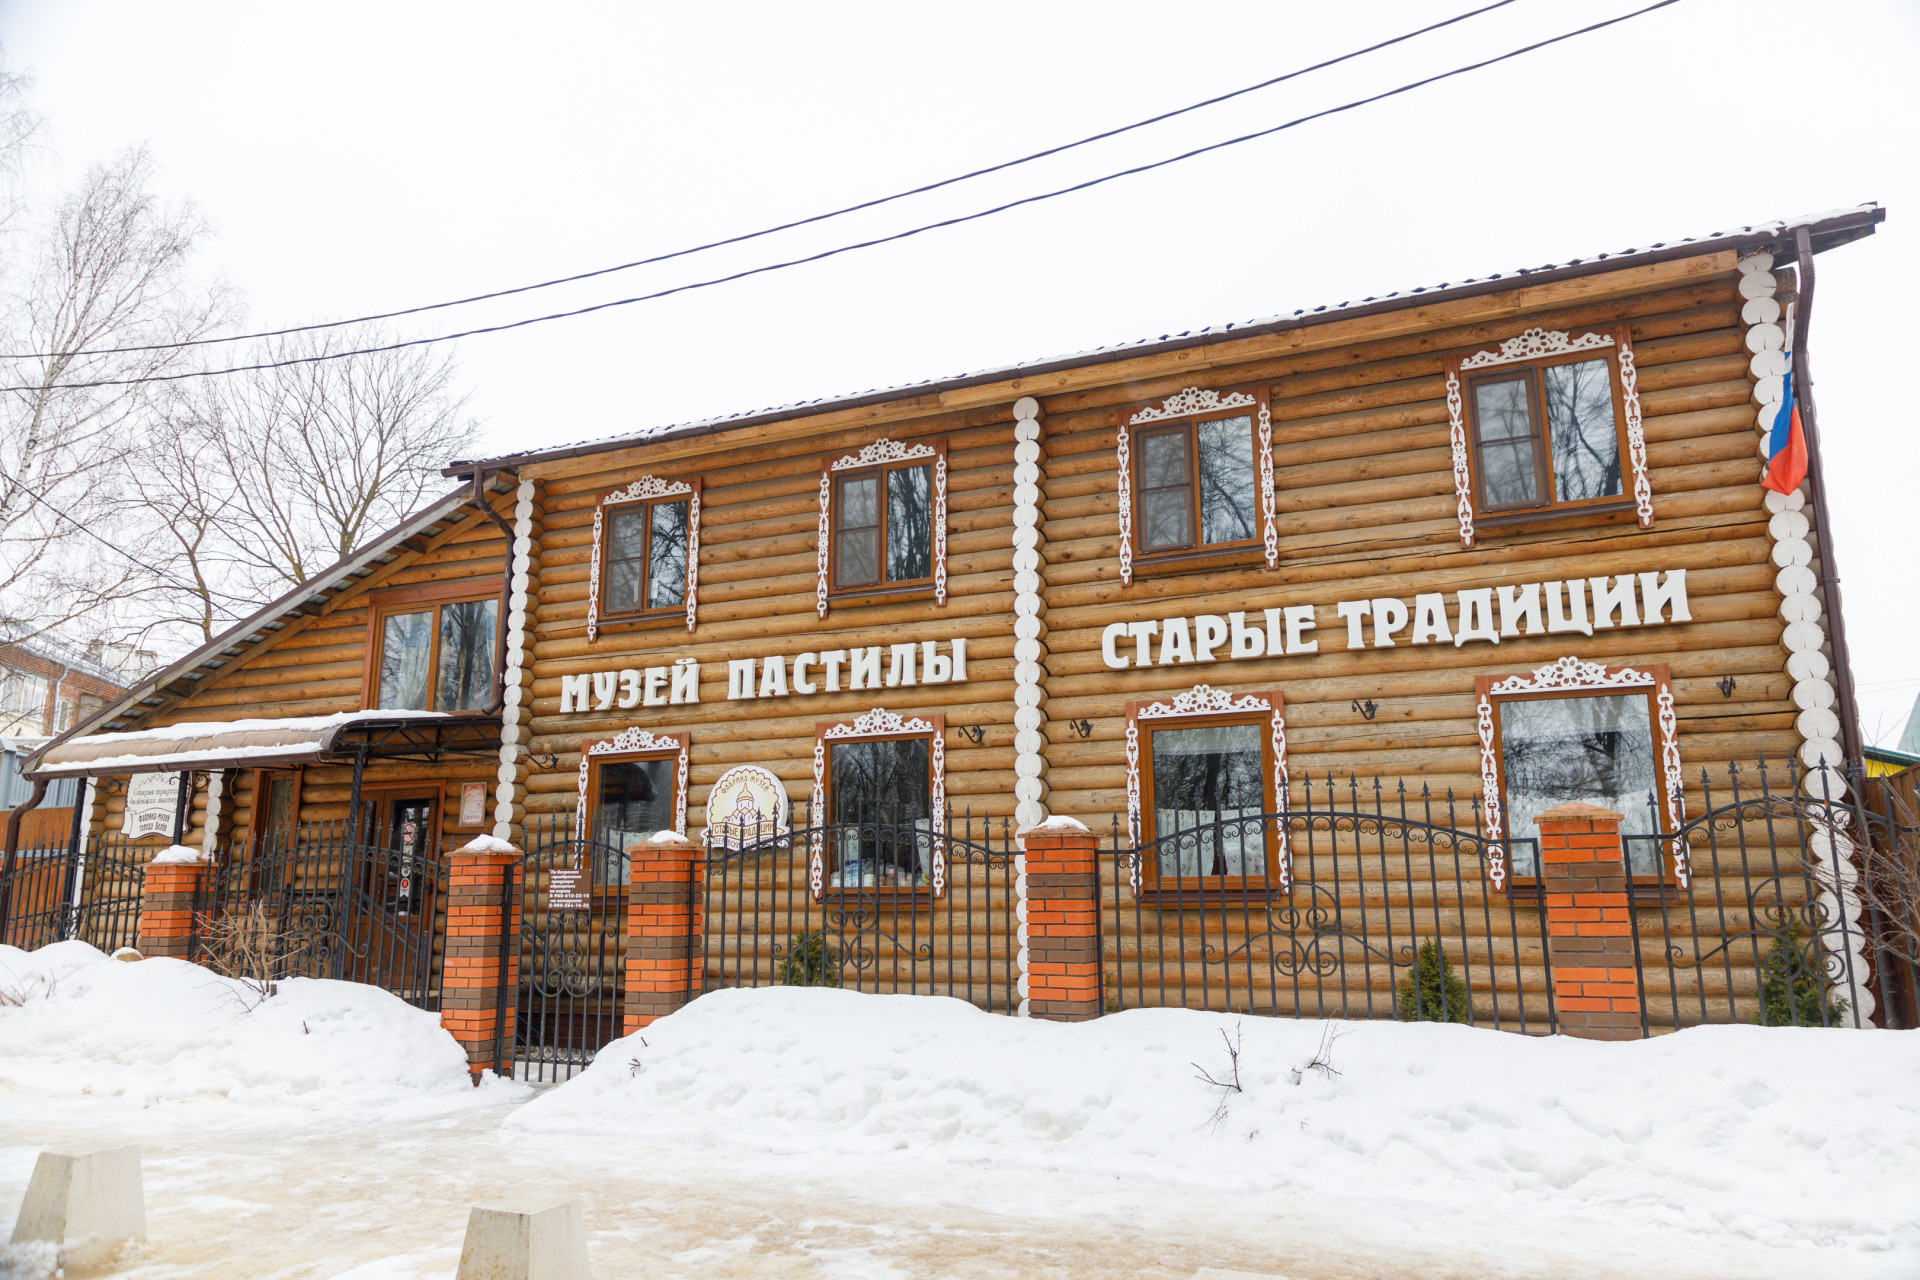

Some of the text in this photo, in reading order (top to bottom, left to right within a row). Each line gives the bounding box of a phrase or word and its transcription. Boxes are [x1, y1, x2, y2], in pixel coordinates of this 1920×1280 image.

[1101, 568, 1693, 669] СТАРЫЕ ТРАДИЦИИ
[559, 637, 968, 713] МУЗЕЙ ПАСТИЛЫ
